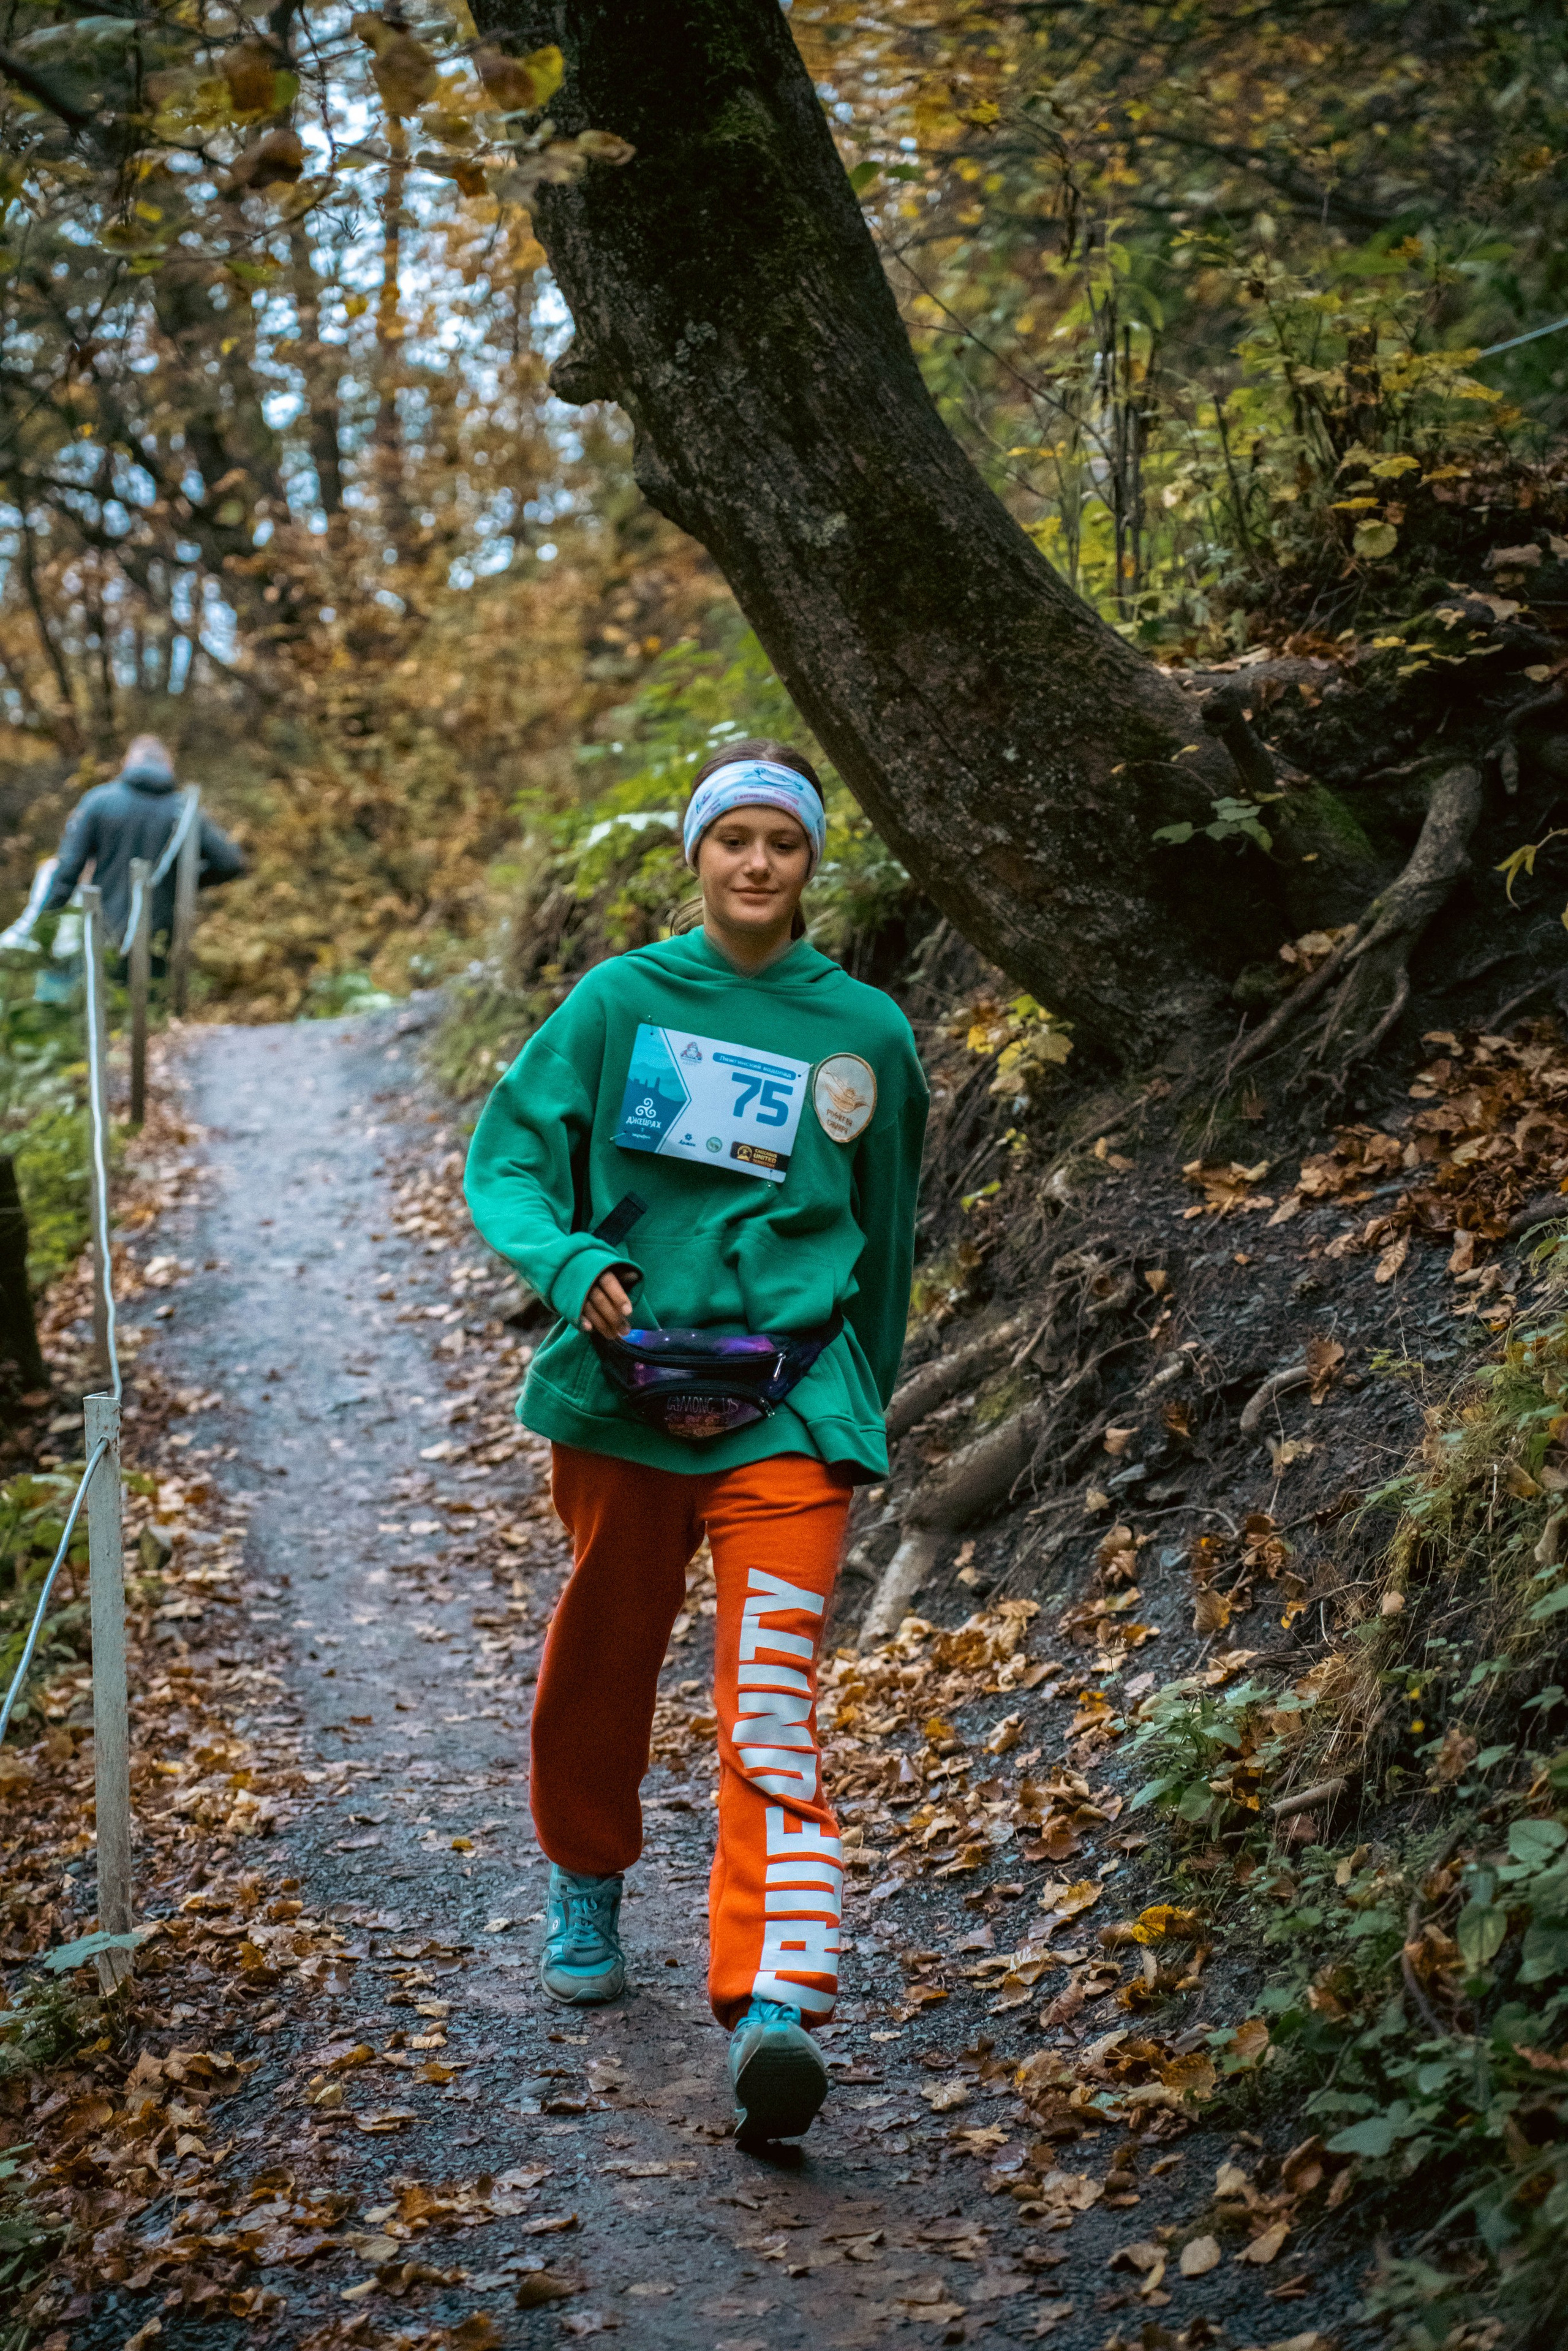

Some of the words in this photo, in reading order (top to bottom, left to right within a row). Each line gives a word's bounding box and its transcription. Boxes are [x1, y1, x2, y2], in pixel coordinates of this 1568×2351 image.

[763, 1066, 791, 1078] водопад
[731, 1071, 794, 1126] 75
[753, 1153, 777, 1163] UNITED
[732, 1568, 825, 1802] UNITY
